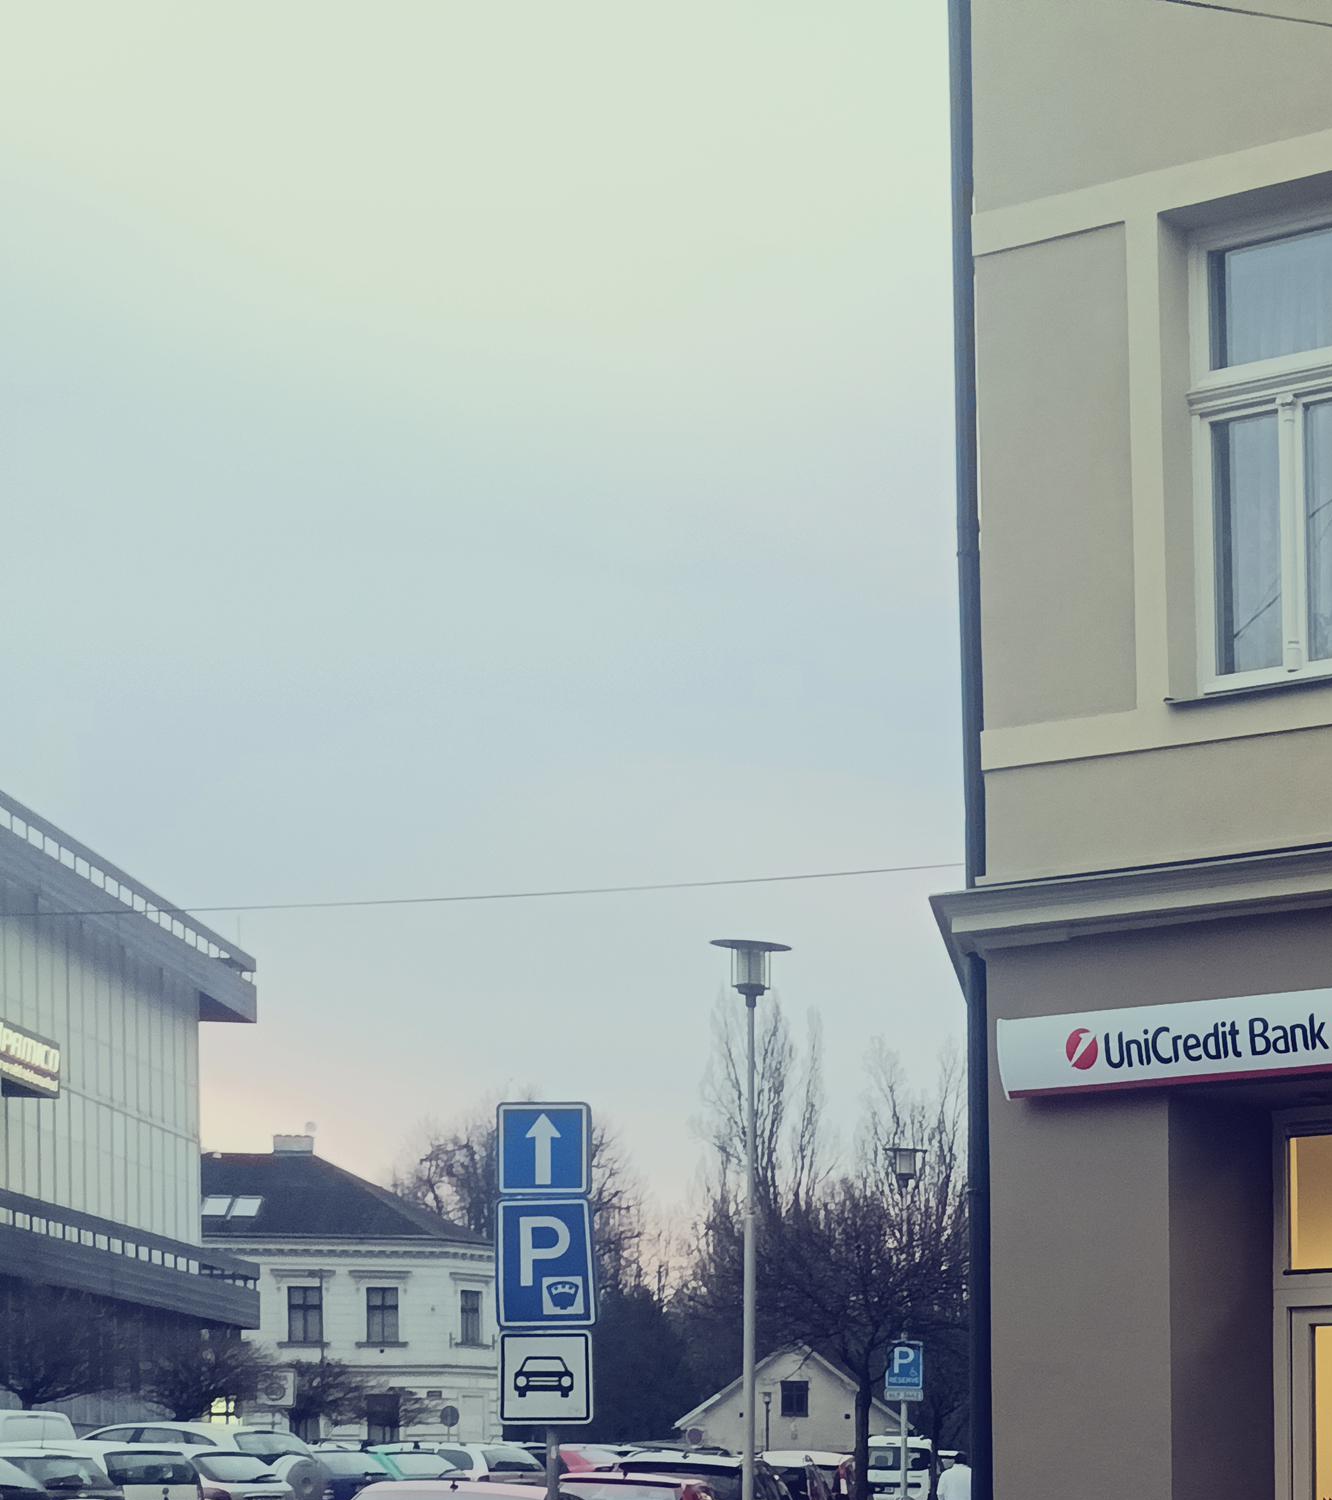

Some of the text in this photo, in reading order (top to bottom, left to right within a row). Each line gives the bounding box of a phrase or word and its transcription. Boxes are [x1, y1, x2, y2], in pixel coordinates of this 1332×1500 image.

[1104, 1020, 1242, 1069] UniCredit
[1249, 1013, 1329, 1056] Bank
[519, 1215, 571, 1287] P
[893, 1346, 915, 1374] P
